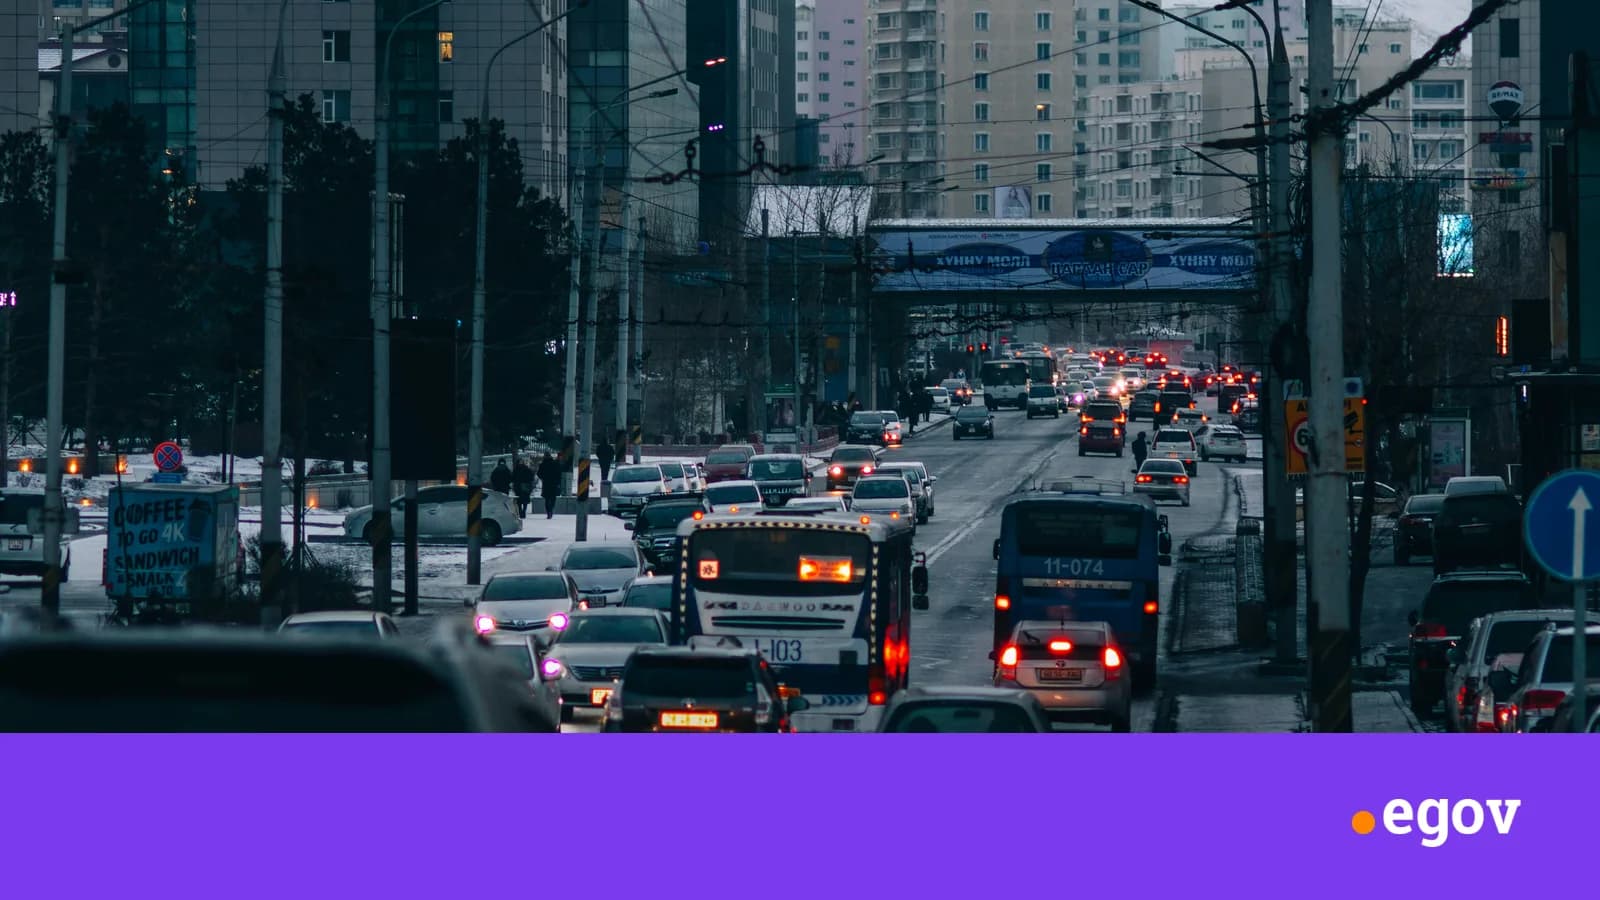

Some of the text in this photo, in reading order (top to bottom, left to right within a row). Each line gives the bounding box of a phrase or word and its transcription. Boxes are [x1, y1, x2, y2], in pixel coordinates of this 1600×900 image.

[1118, 261, 1149, 277] САР
[114, 498, 185, 528] COFFEE
[117, 530, 135, 548] TO
[139, 527, 159, 545] GO
[114, 546, 200, 570] SANDWICH
[1043, 557, 1105, 576] 11-074
